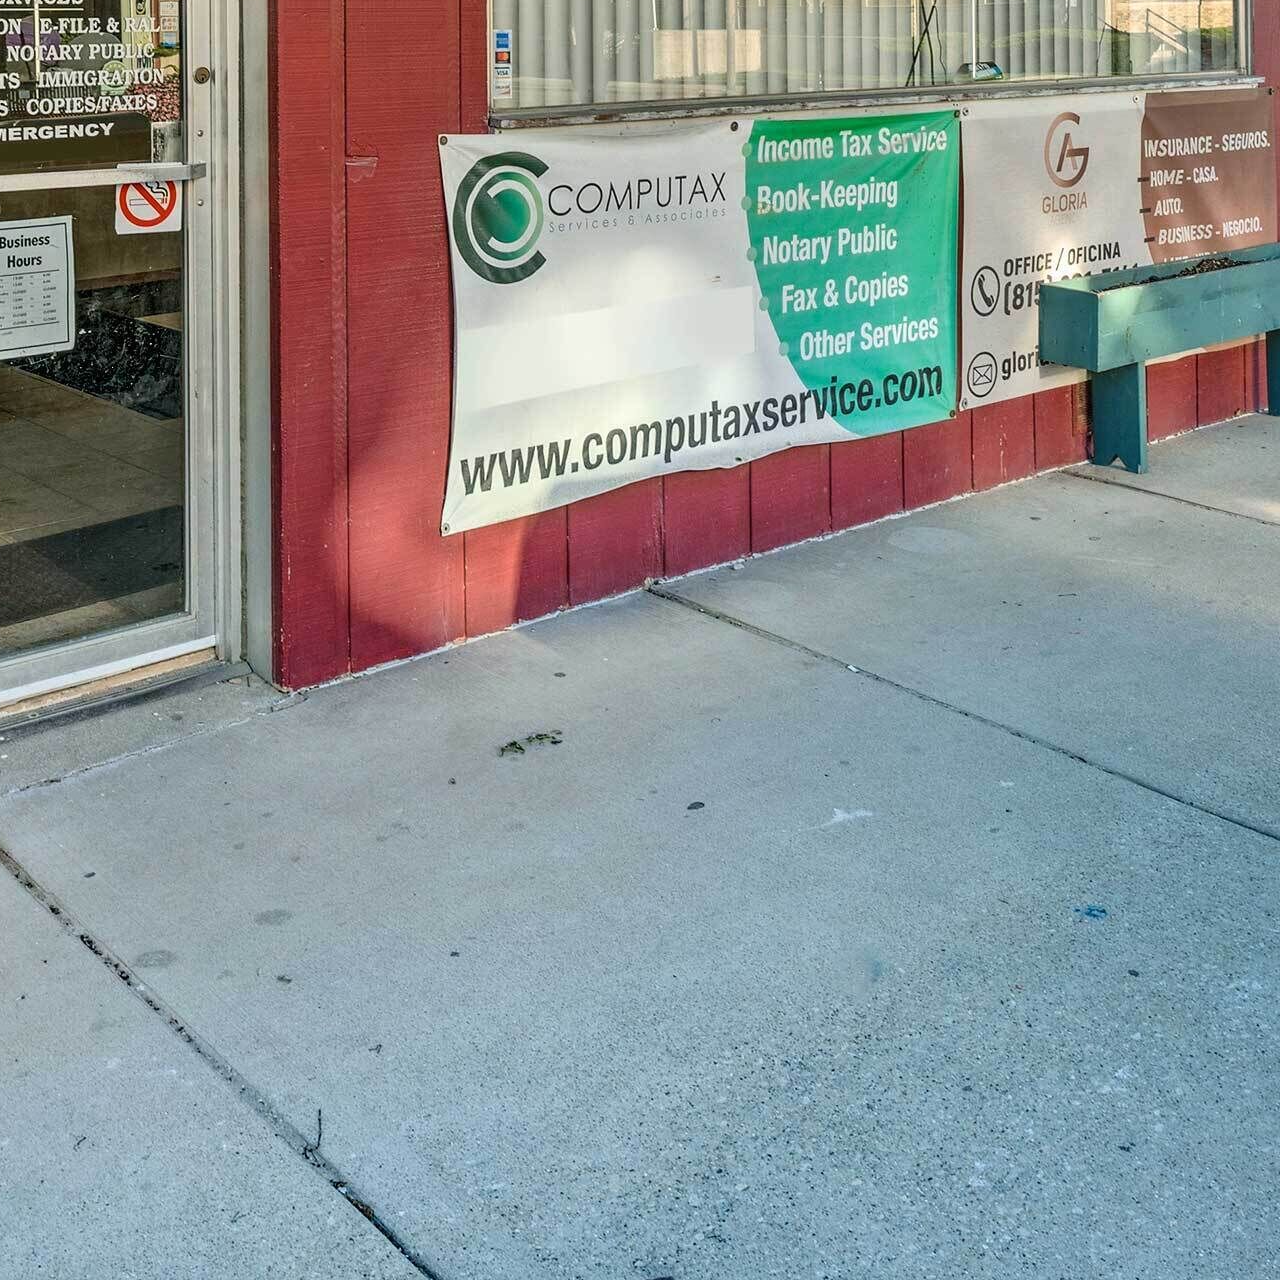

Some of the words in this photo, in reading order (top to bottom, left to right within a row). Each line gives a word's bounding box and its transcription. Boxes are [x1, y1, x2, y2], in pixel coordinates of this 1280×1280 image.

[39, 18, 102, 35] E-FILE
[106, 18, 120, 33] &
[6, 44, 84, 62] NOTARY
[88, 42, 155, 60] PUBLIC
[36, 69, 165, 88] IMMIGRATION
[26, 95, 158, 116] COPIES/FAXES
[757, 135, 834, 163] Income
[839, 130, 872, 157] Tax
[878, 126, 948, 155] Service
[1144, 135, 1212, 158] INSURANCE
[1222, 130, 1270, 152] SEGUROS.
[1150, 169, 1184, 187] HOME
[1193, 166, 1219, 184] CASA.
[548, 172, 727, 217] COMPUTAX
[757, 176, 898, 215] Book-Keeping
[1042, 191, 1088, 215] GLORIA
[1153, 197, 1184, 217] AUTO.
[549, 218, 618, 233] Services
[627, 214, 637, 226] &
[1158, 223, 1213, 245] BUSINESS
[1222, 216, 1263, 238] NEGOCIO.
[763, 234, 832, 265] Notary
[838, 223, 897, 256] Public
[7, 255, 43, 268] Hours
[1003, 252, 1053, 277] OFFICE
[1055, 247, 1065, 271] /
[1067, 242, 1121, 266] OFICINA
[782, 284, 818, 314] Fax
[823, 279, 839, 307] &
[845, 272, 908, 306] Copies
[799, 329, 855, 361] Other
[860, 316, 938, 351] Services
[460, 363, 944, 496] www.computaxservice.com
